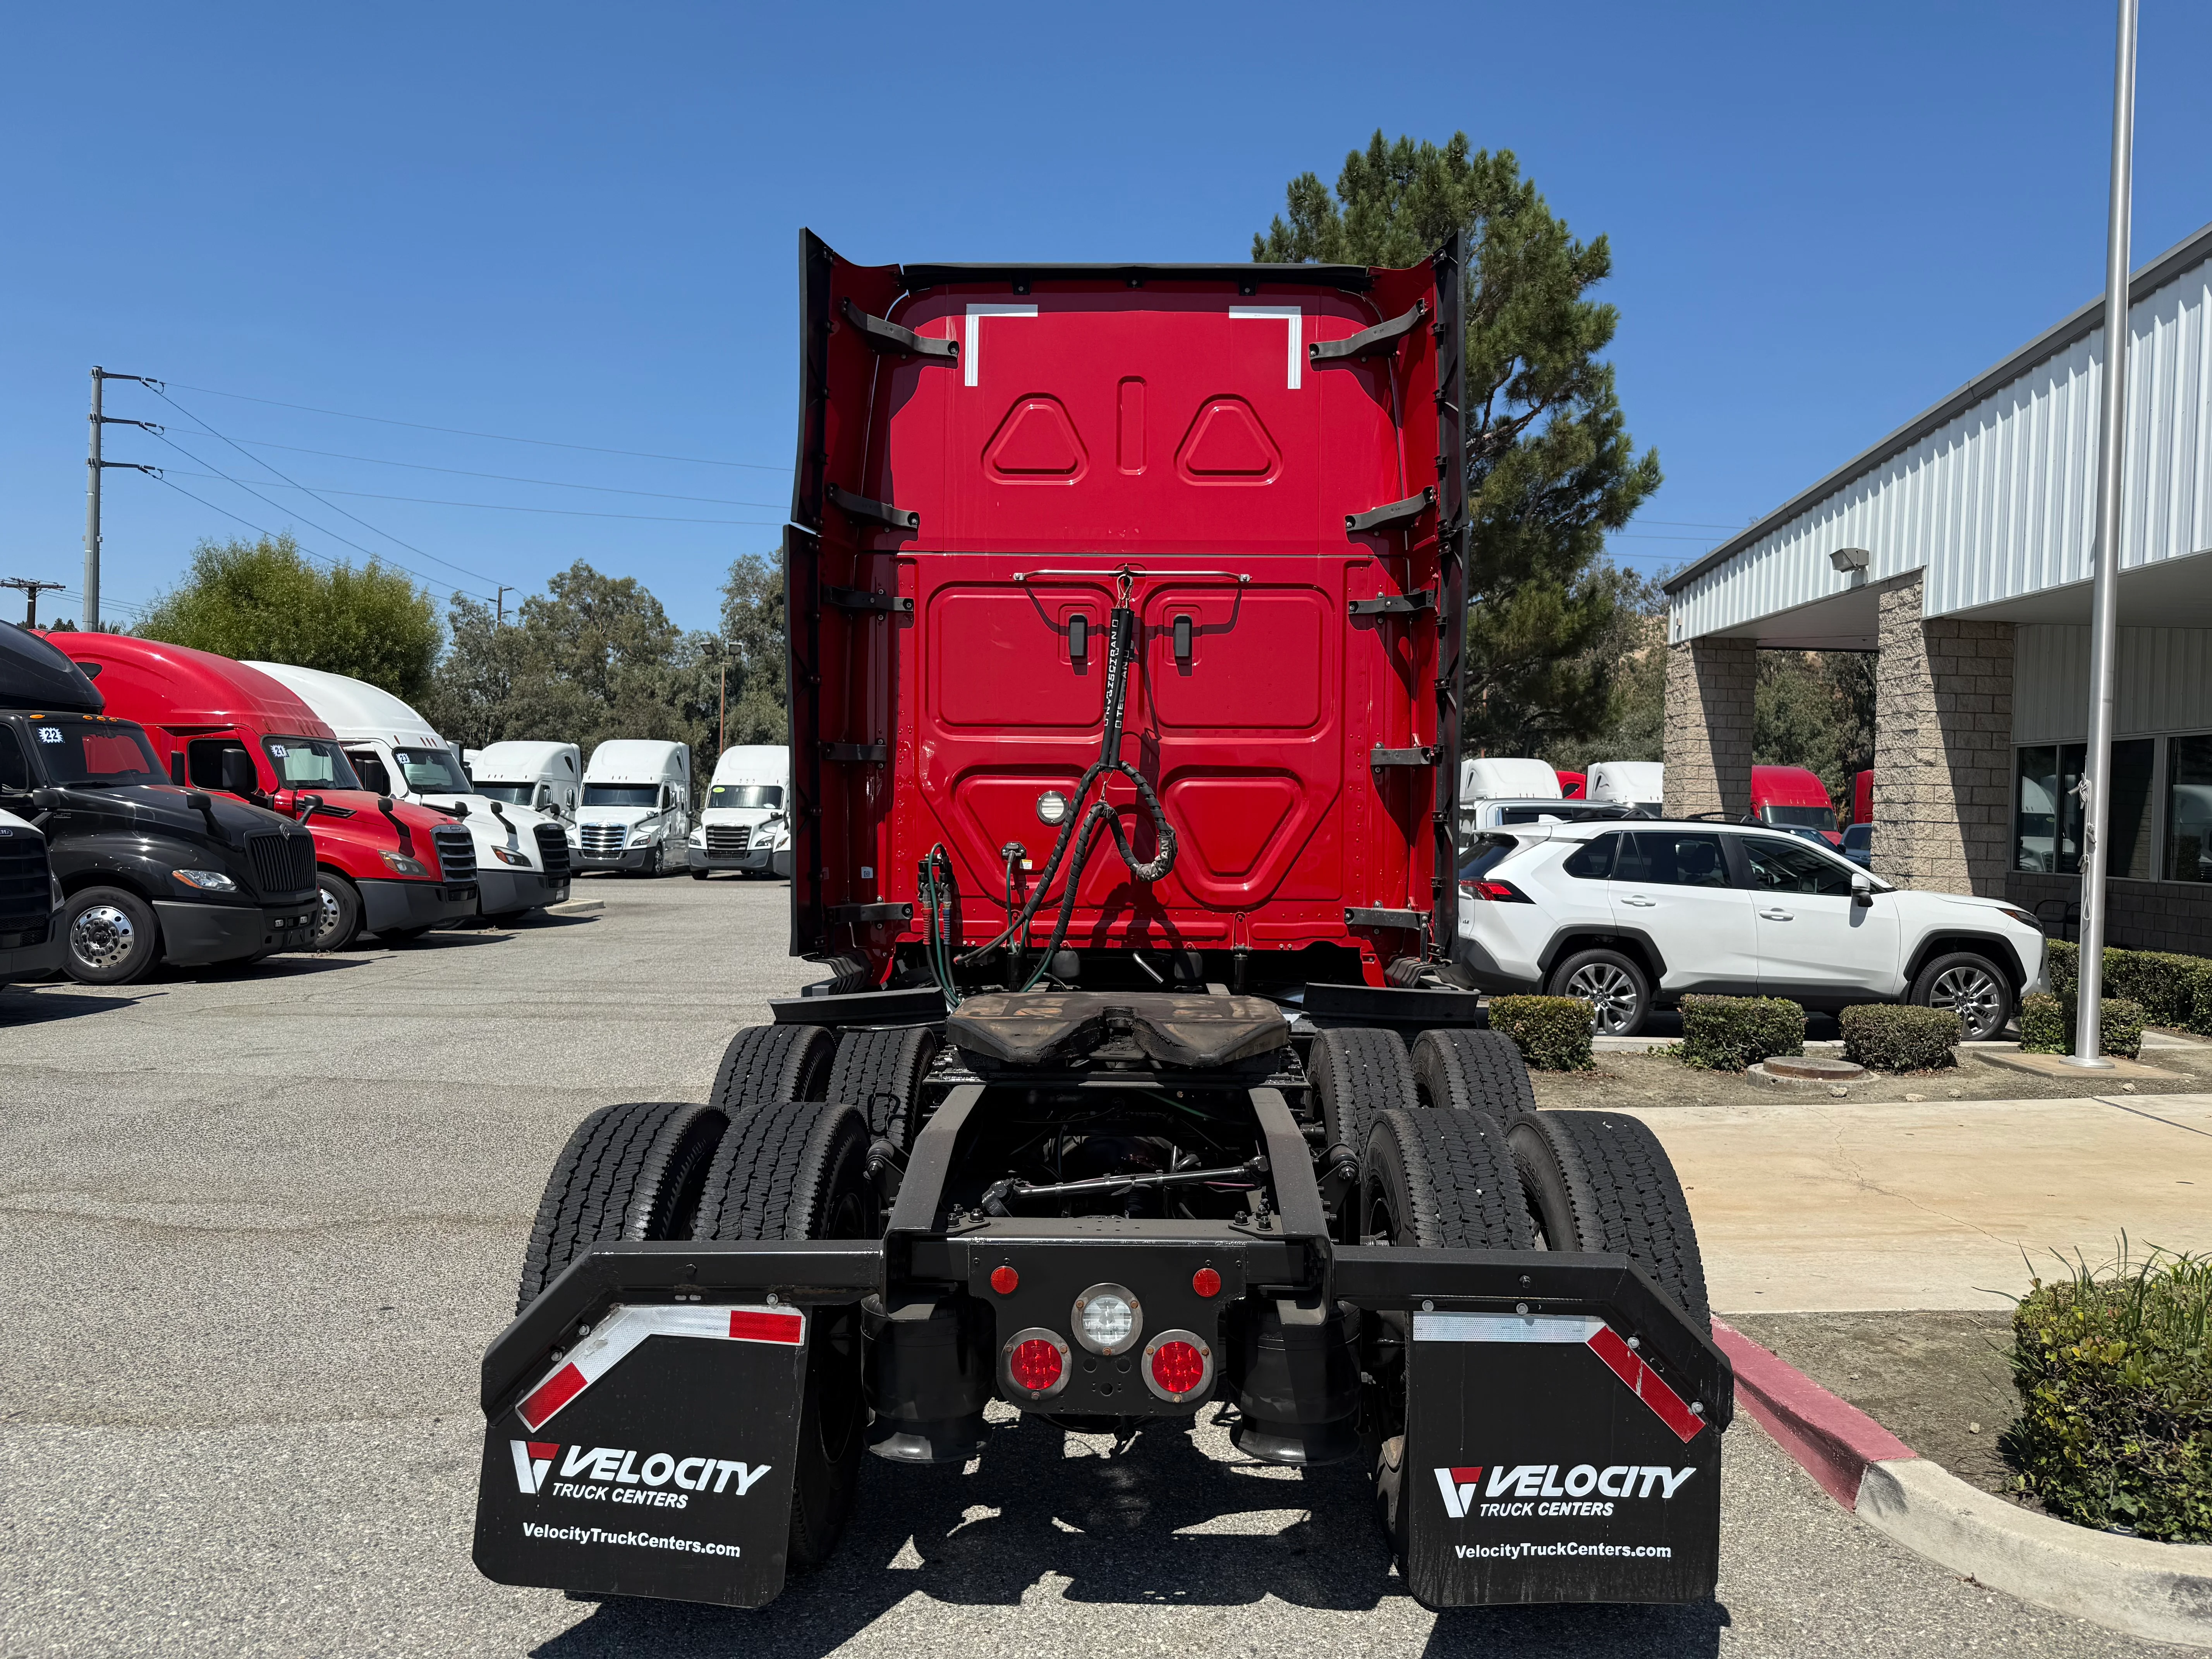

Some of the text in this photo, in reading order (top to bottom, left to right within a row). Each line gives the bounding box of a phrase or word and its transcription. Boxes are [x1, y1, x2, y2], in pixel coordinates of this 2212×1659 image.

[45, 730, 58, 740] 22
[560, 1445, 771, 1496] VELOCITY
[1485, 1464, 1697, 1499] VELOCITY
[553, 1482, 689, 1509] TRUCK CENTERS
[1480, 1502, 1614, 1517] TRUCK CENTERS
[523, 1522, 740, 1558] VelocityTruckCenters.com
[1455, 1542, 1671, 1559] VelocityTruckCenters.com
